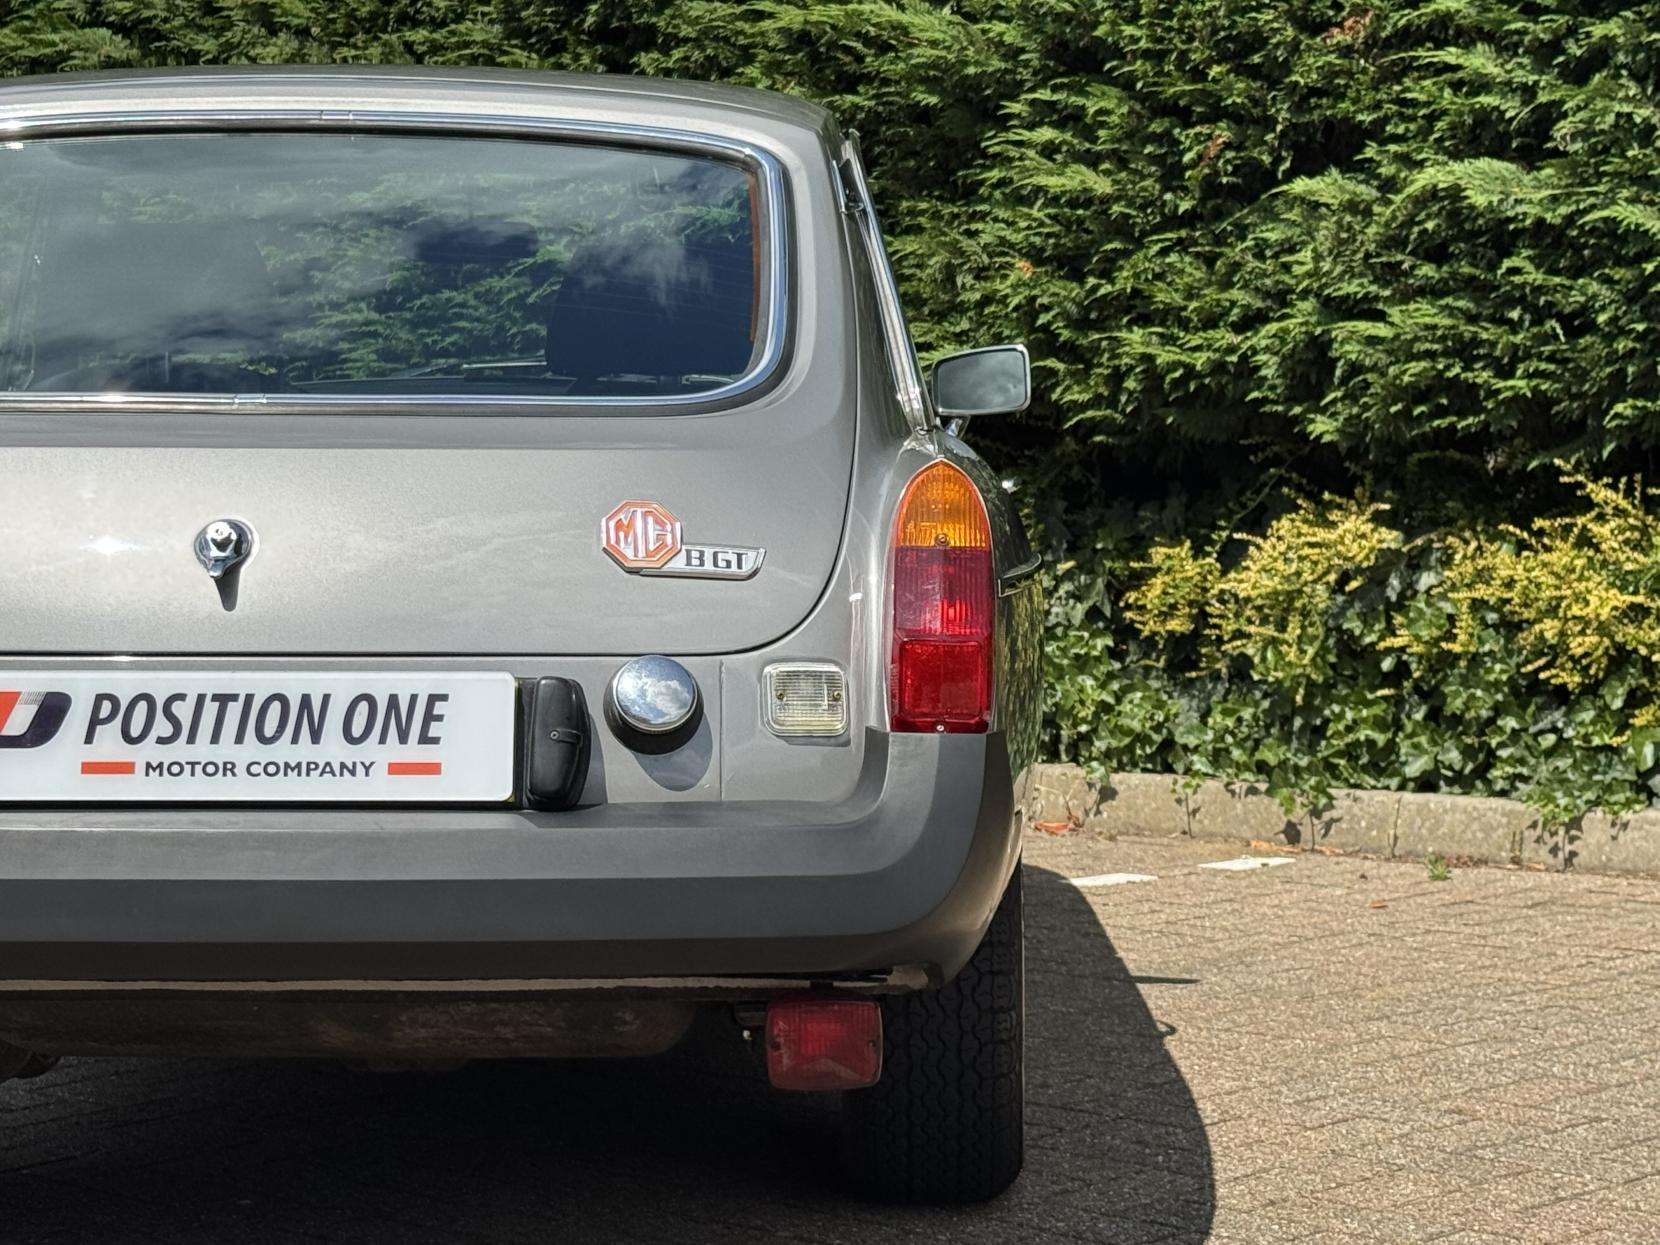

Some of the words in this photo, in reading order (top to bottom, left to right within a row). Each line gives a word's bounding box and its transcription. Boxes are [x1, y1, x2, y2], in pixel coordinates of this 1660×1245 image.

[606, 507, 675, 559] MG
[84, 692, 331, 746] POSITION
[342, 692, 450, 746] ONE
[144, 760, 237, 778] MOTOR
[245, 760, 376, 778] COMPANY
